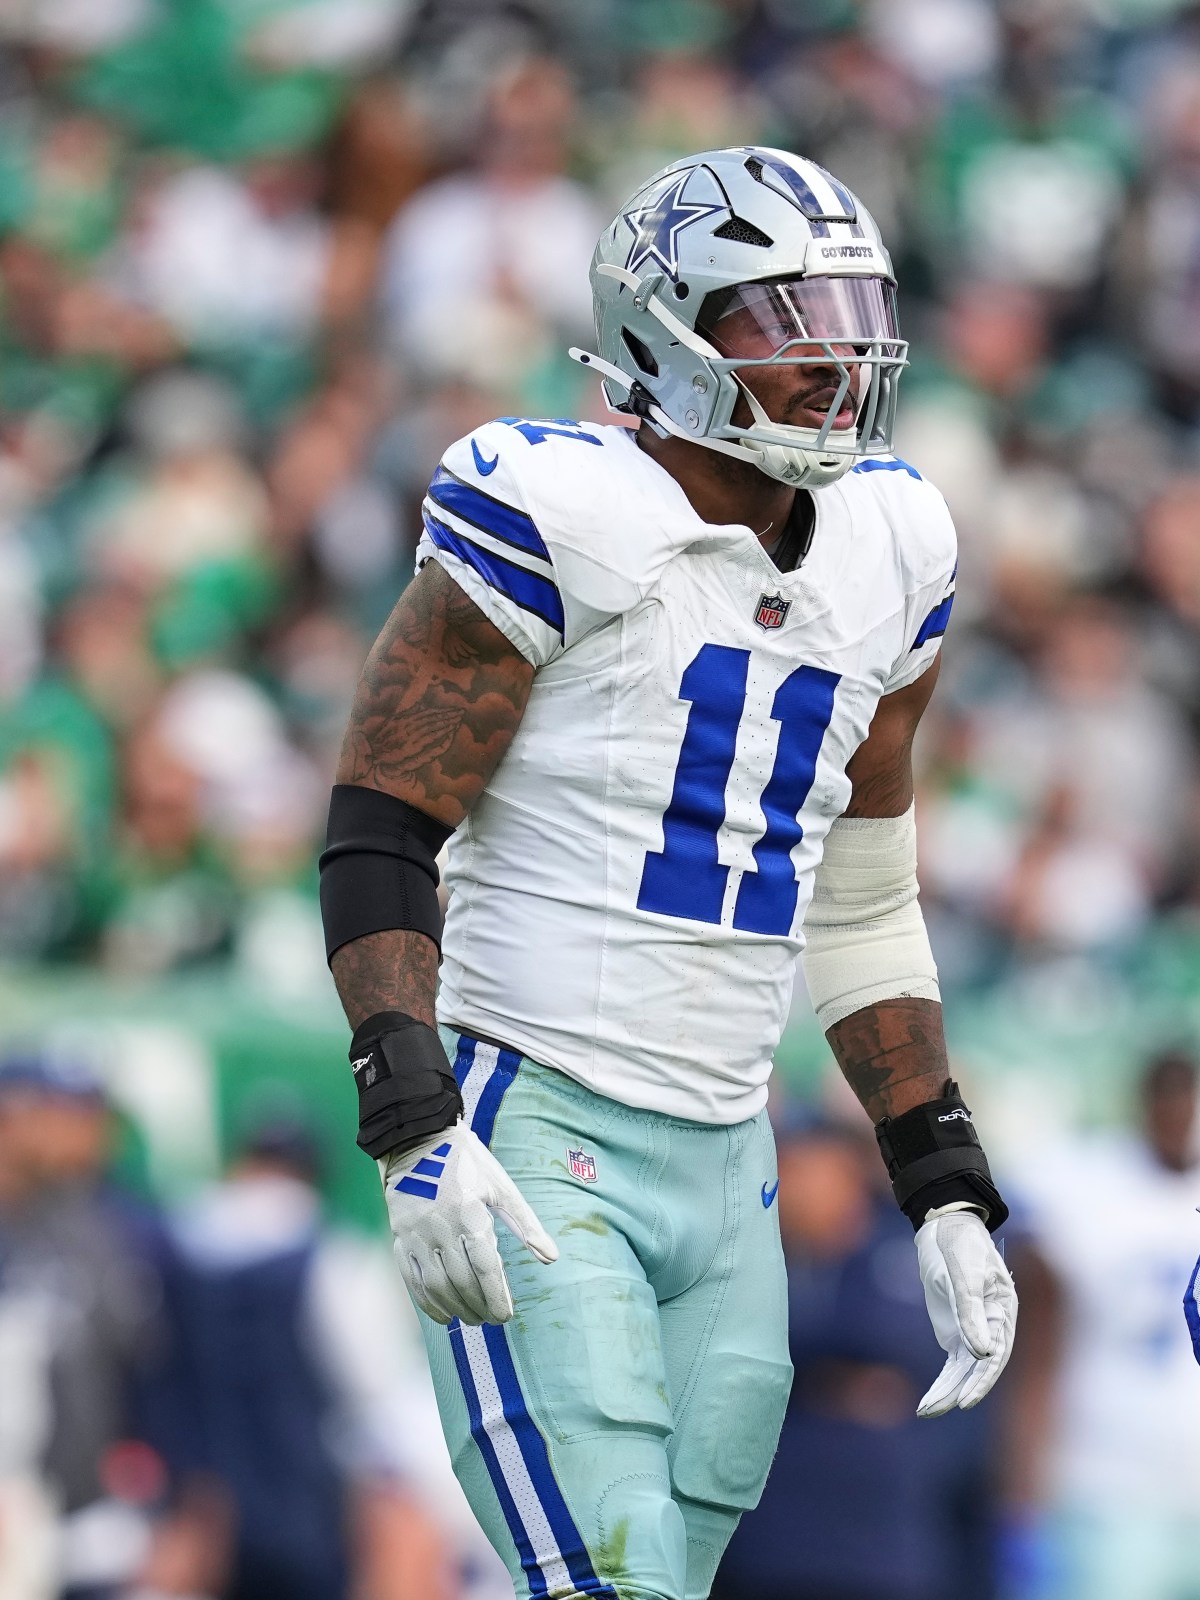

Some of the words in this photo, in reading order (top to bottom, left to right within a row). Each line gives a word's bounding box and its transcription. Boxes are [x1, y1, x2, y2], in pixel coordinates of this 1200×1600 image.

[821, 246, 874, 258] COWBOYS
[758, 608, 782, 626] NFL
[636, 643, 842, 937] 11
[573, 1161, 594, 1178] NFL
